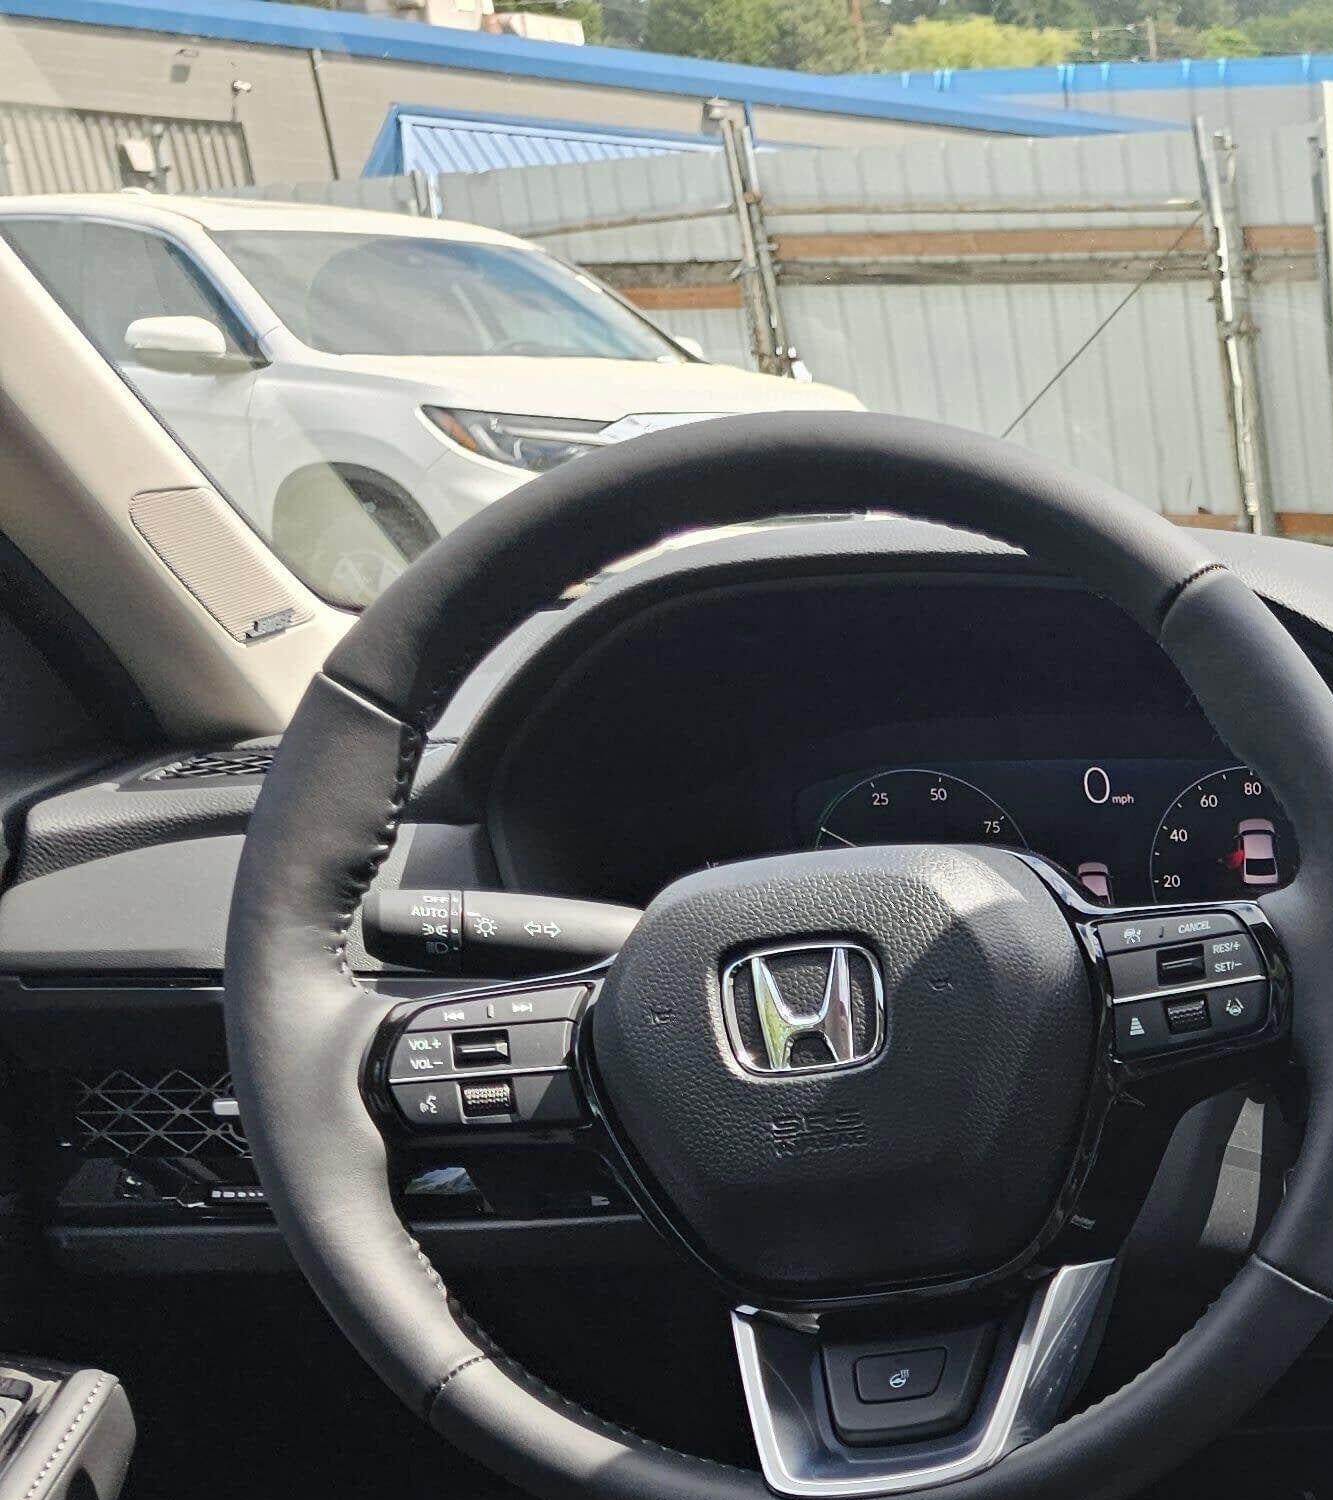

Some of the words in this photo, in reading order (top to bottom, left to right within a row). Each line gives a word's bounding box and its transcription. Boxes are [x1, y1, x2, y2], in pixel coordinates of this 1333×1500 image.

[1084, 767, 1109, 803] 0
[1112, 794, 1134, 806] mph
[1244, 781, 1262, 795] 80
[872, 792, 888, 806] 25
[930, 788, 948, 801] 50
[1200, 794, 1217, 808] 60
[984, 820, 1000, 834] 75
[1169, 829, 1188, 843] 40
[1163, 874, 1181, 887] 20
[411, 904, 448, 918] AUTO
[1178, 920, 1211, 934] CANCEL
